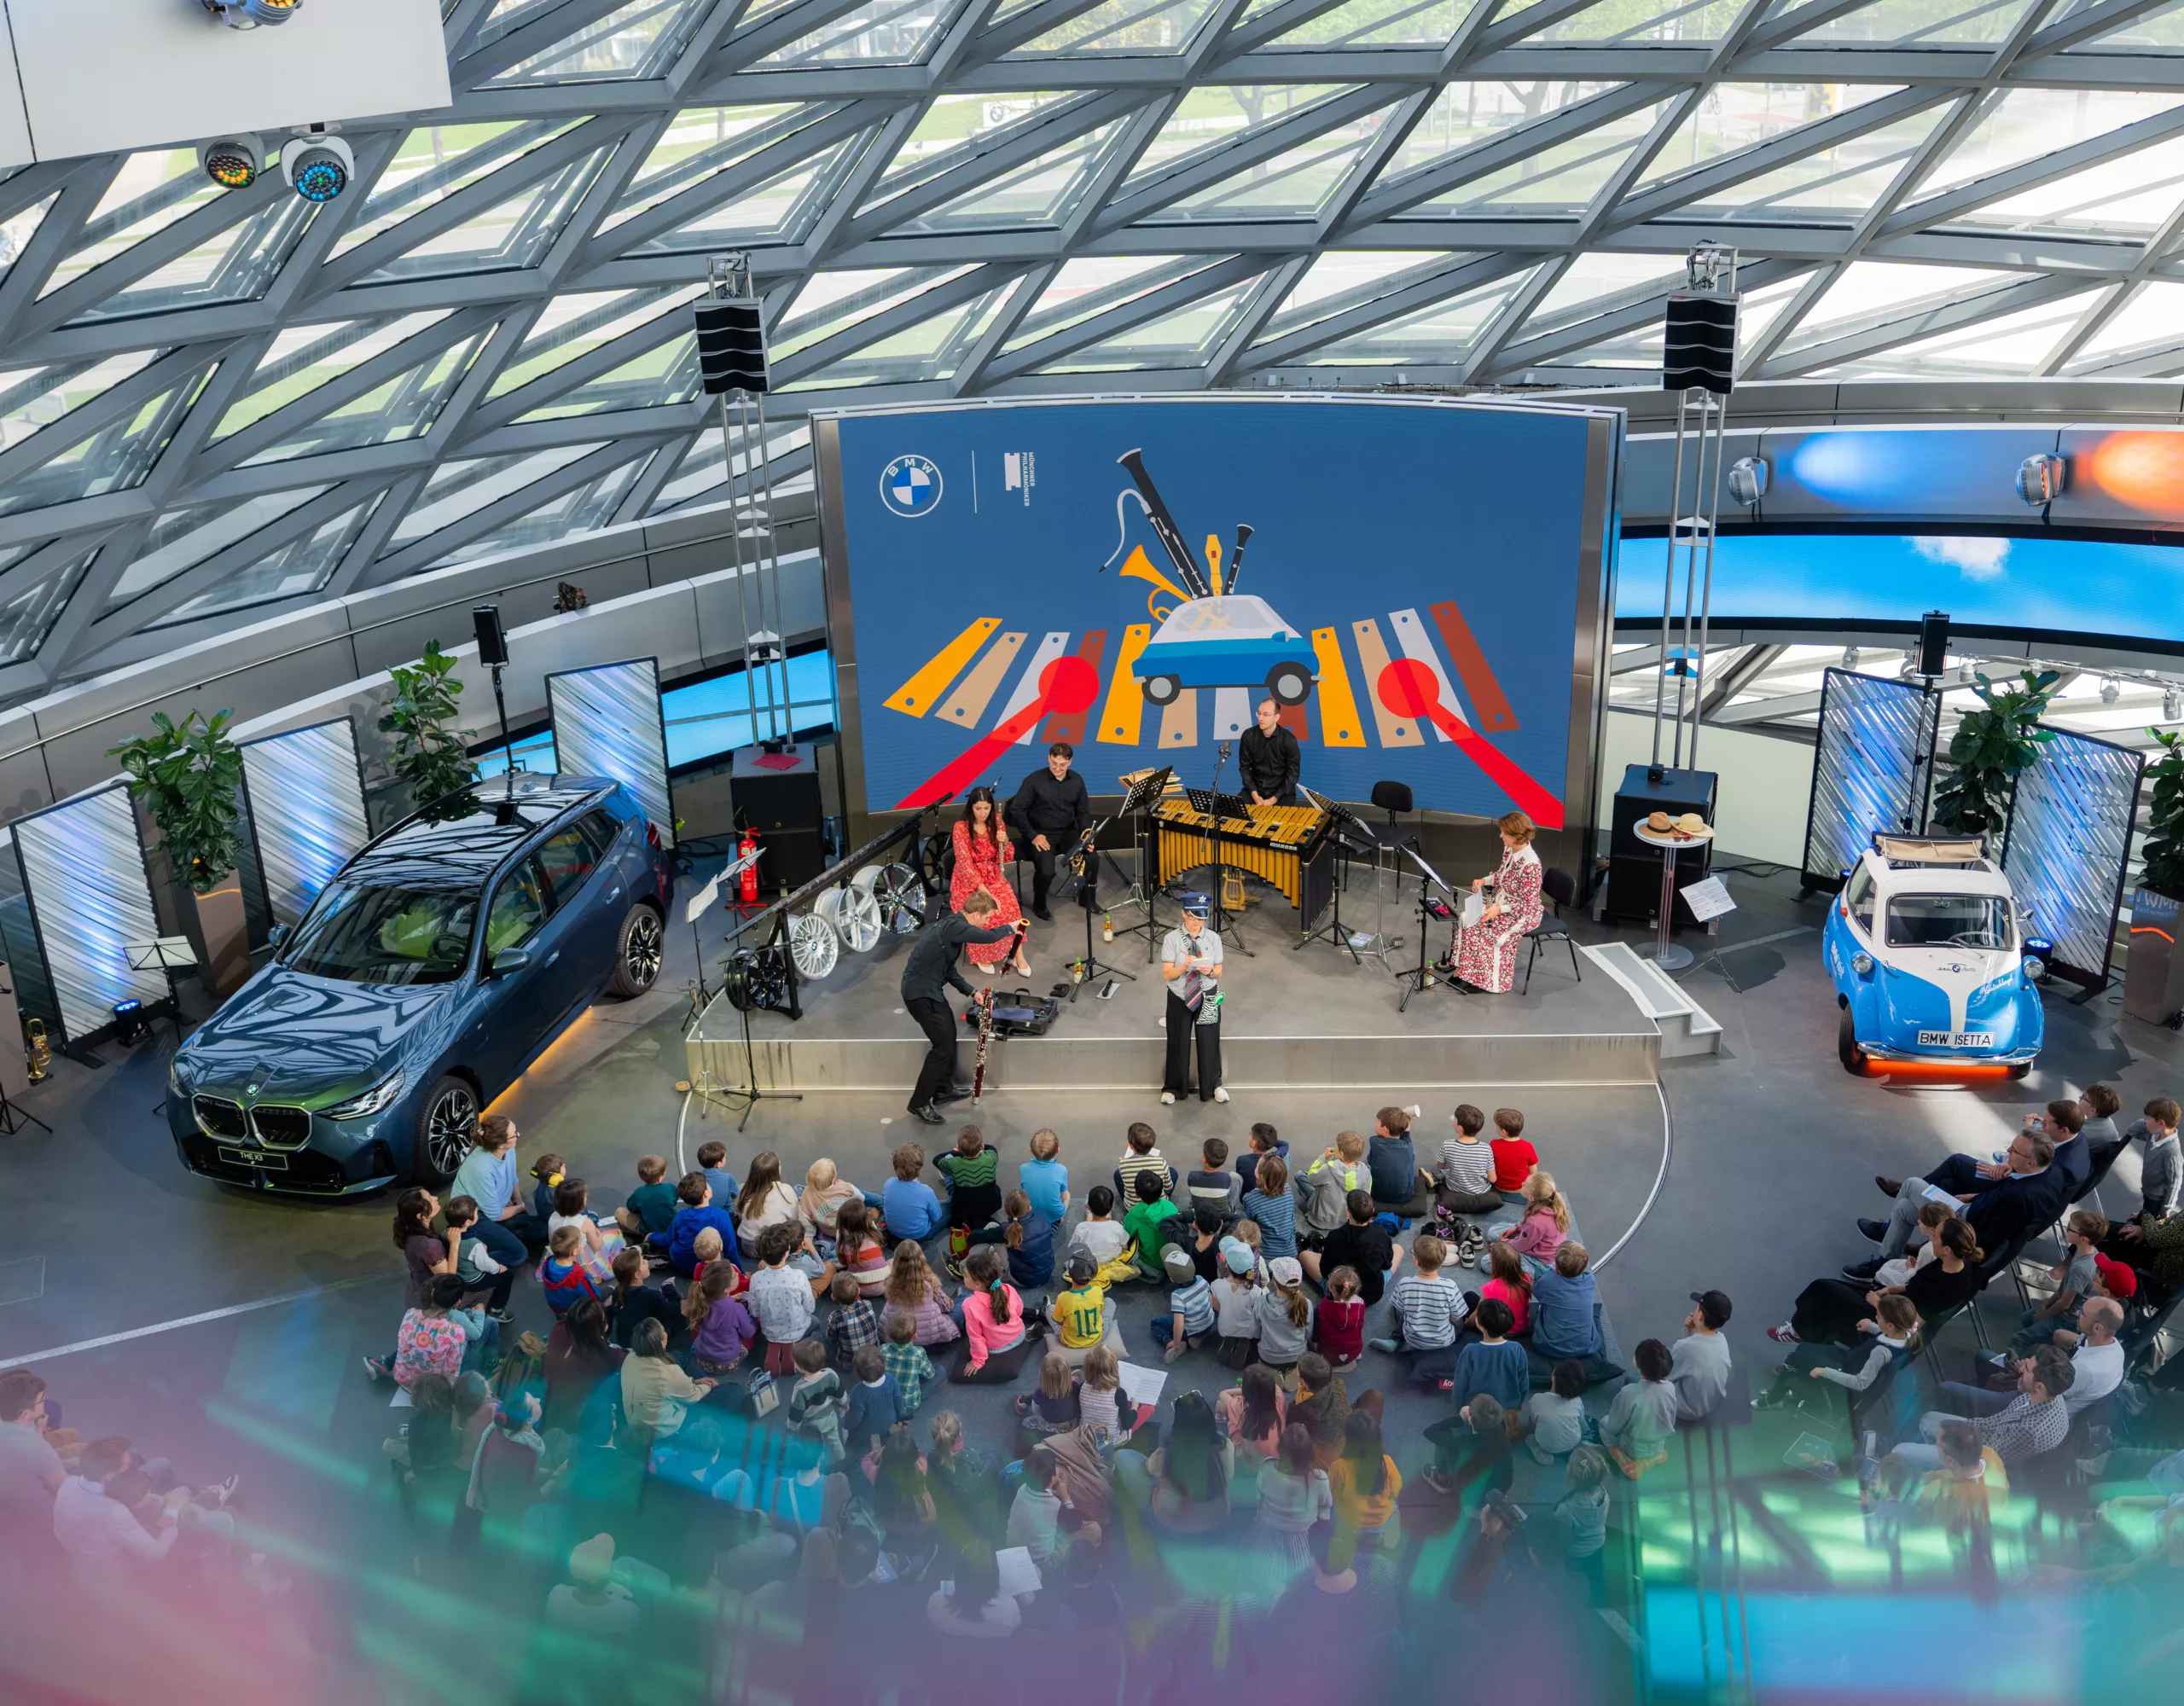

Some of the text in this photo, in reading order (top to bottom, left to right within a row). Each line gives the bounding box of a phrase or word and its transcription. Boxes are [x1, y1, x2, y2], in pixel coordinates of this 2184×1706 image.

[887, 458, 933, 477] BMW
[1920, 1032, 1991, 1046] BMW ISETTA
[240, 1152, 254, 1160] THE
[1073, 1306, 1100, 1338] 10
